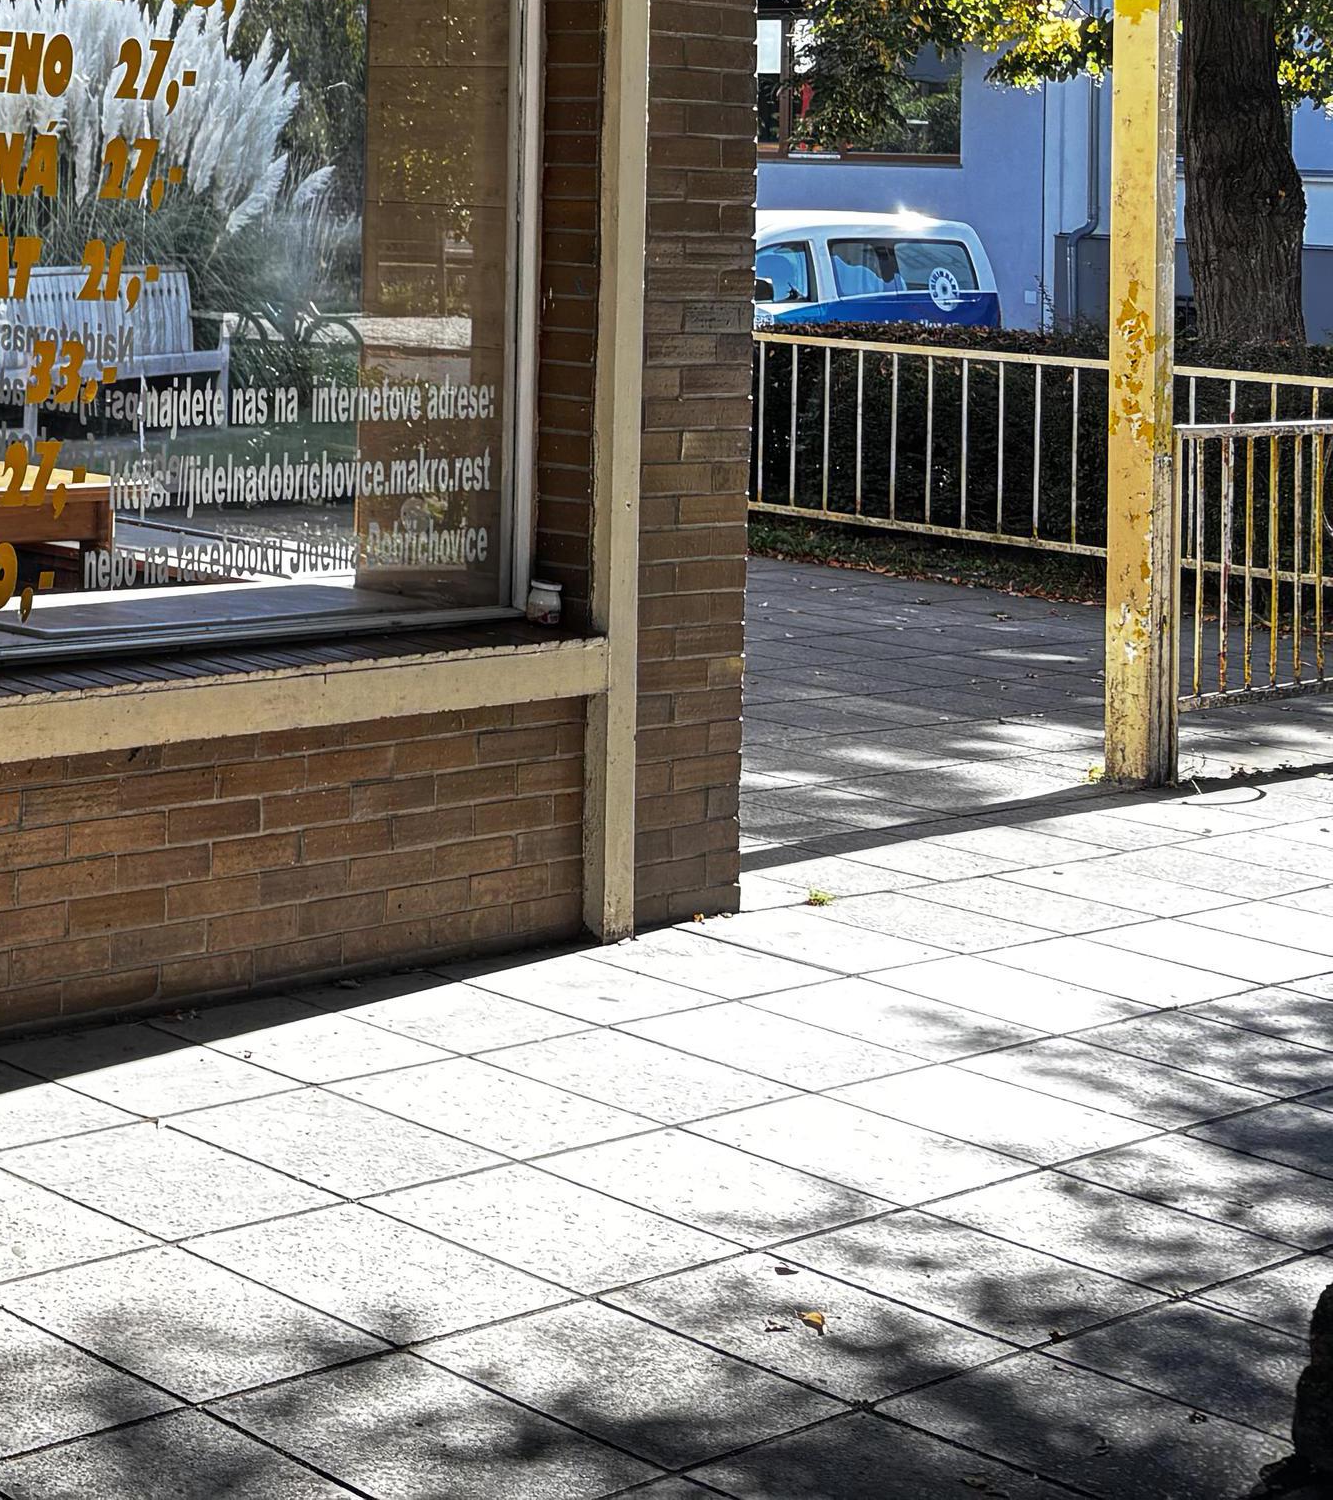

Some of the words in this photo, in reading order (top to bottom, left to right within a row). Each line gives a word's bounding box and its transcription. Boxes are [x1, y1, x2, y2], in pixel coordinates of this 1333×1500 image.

[113, 36, 197, 116] 27,-
[76, 238, 161, 313] 21,-
[232, 374, 269, 426] nás
[274, 385, 299, 424] na
[311, 372, 422, 423] internetové
[426, 375, 496, 421] adrese:
